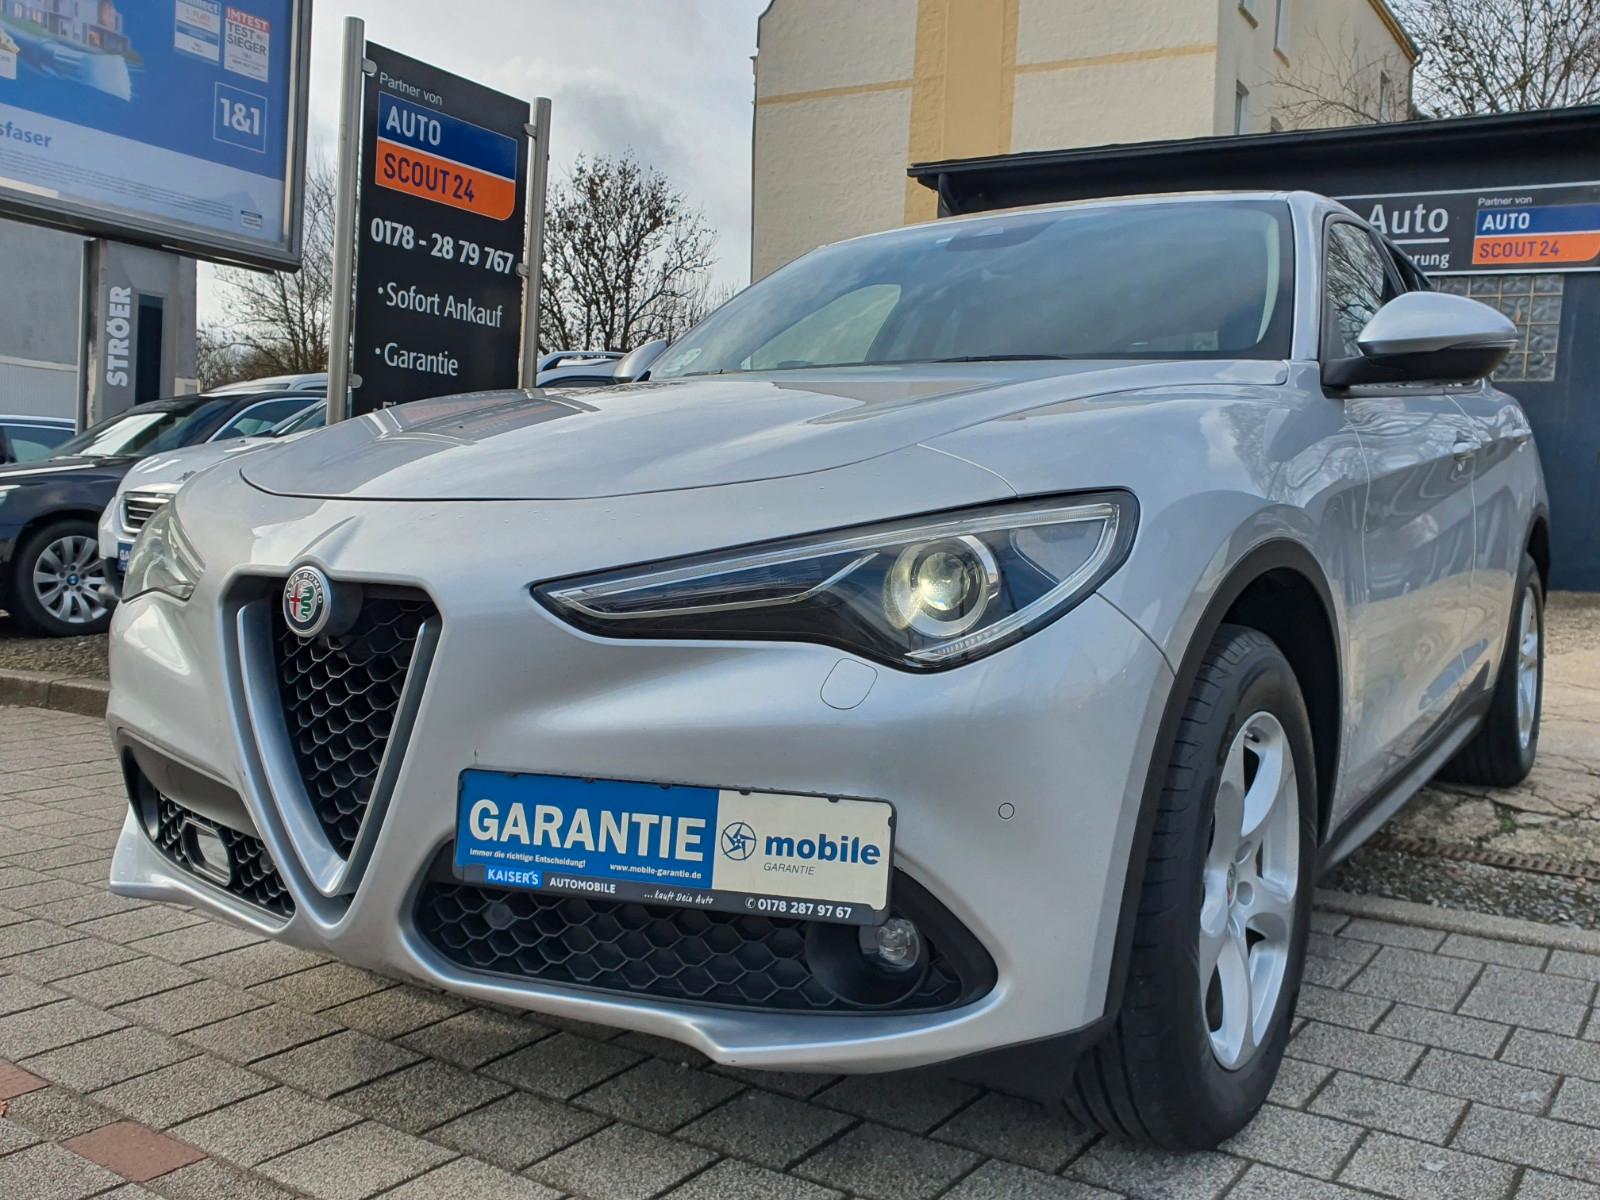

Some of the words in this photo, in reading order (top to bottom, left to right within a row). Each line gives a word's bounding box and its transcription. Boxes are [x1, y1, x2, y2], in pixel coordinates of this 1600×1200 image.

[226, 33, 267, 56] SIEGER
[379, 71, 420, 97] Partner
[423, 90, 443, 106] von
[220, 98, 260, 136] 1&1
[385, 105, 441, 146] AUTO
[1478, 196, 1513, 207] Partner
[1515, 196, 1533, 204] von
[1368, 203, 1449, 234] Auto
[1482, 212, 1530, 231] AUTO
[370, 217, 414, 250] 0178
[430, 233, 454, 260] 28
[458, 240, 480, 266] 79
[484, 246, 515, 274] 767
[444, 295, 503, 328] Ankauf
[106, 286, 131, 387] STRÖER
[469, 798, 707, 862] GARANTIE
[469, 848, 493, 857] Immer
[494, 850, 505, 859] die
[506, 852, 534, 863] richtige
[535, 854, 586, 869] Entscheidung!
[764, 833, 881, 865] mobile
[487, 868, 539, 885] KAISER'S
[549, 877, 616, 894] AUTOMOBILE
[609, 863, 702, 879] www.mobile-garantie.de
[763, 862, 816, 875] GARANTIE
[695, 893, 714, 905] Auto
[757, 898, 787, 912] 0178
[790, 902, 814, 915] 287
[817, 904, 833, 917] 97
[835, 906, 852, 919] 67
